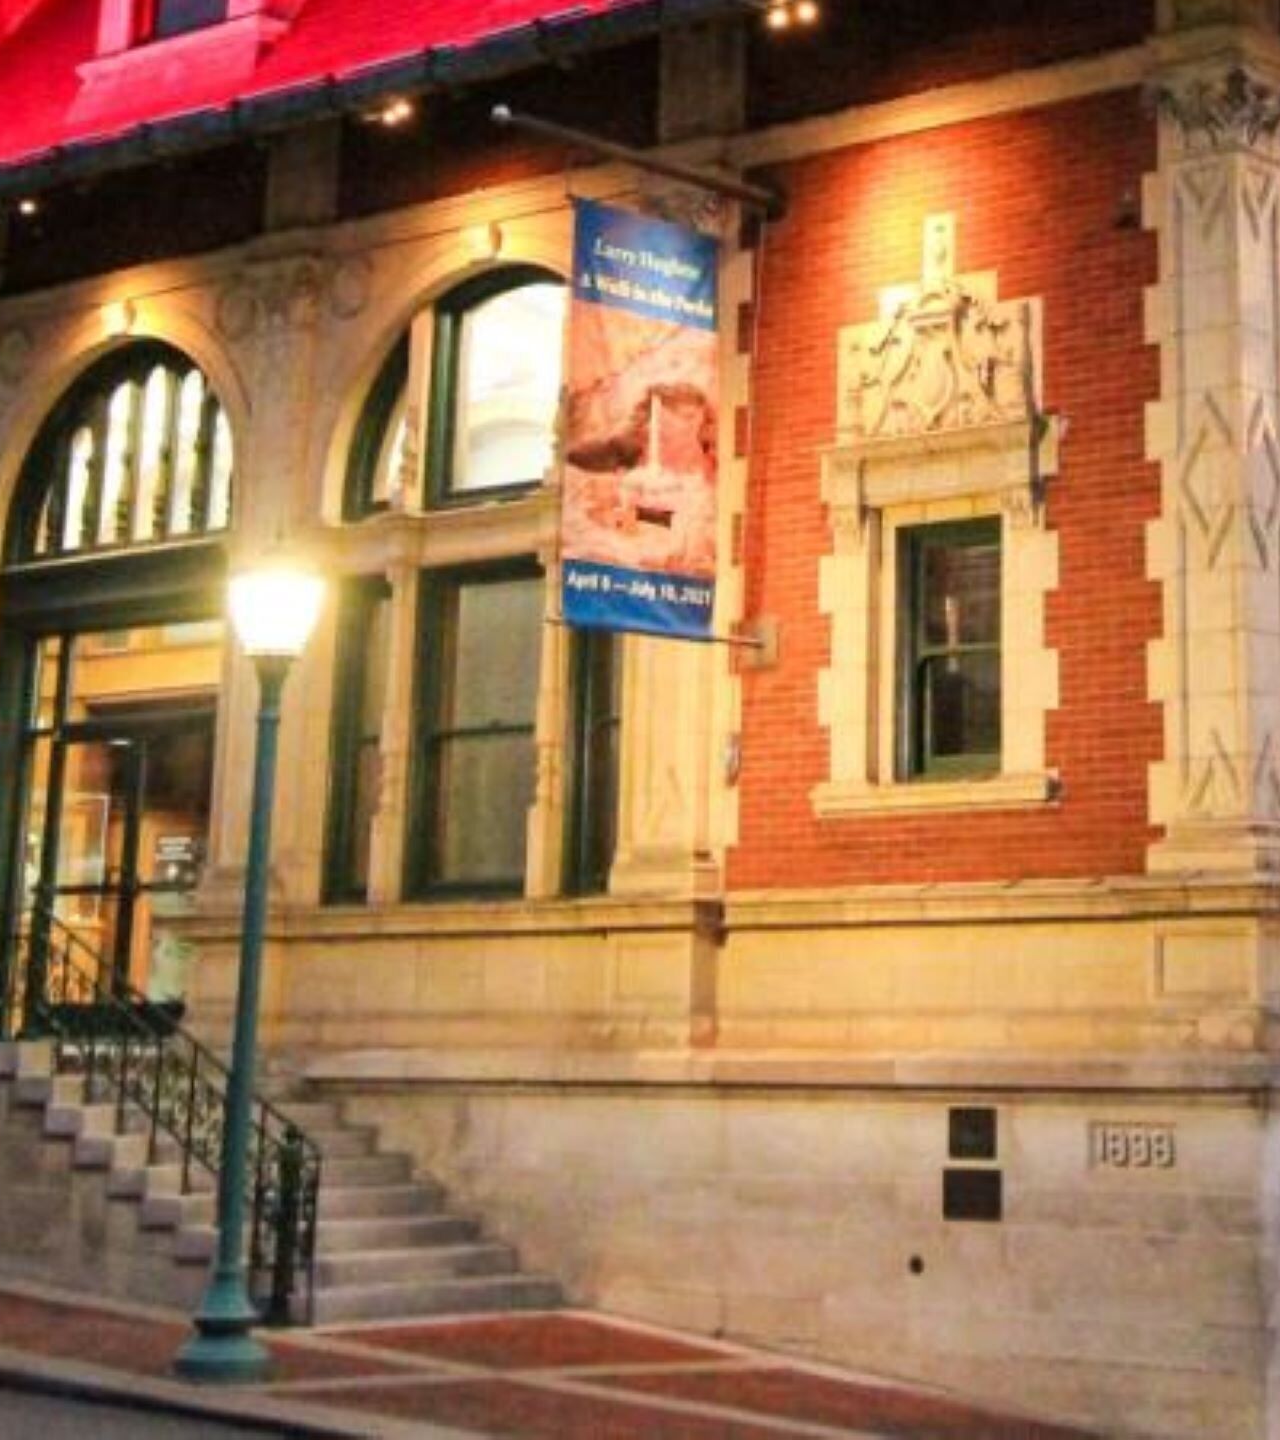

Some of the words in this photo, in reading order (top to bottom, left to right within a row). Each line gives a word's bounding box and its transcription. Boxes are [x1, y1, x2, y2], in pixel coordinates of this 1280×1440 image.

[567, 568, 599, 592] April
[629, 580, 657, 602] July
[679, 586, 712, 607] 2021
